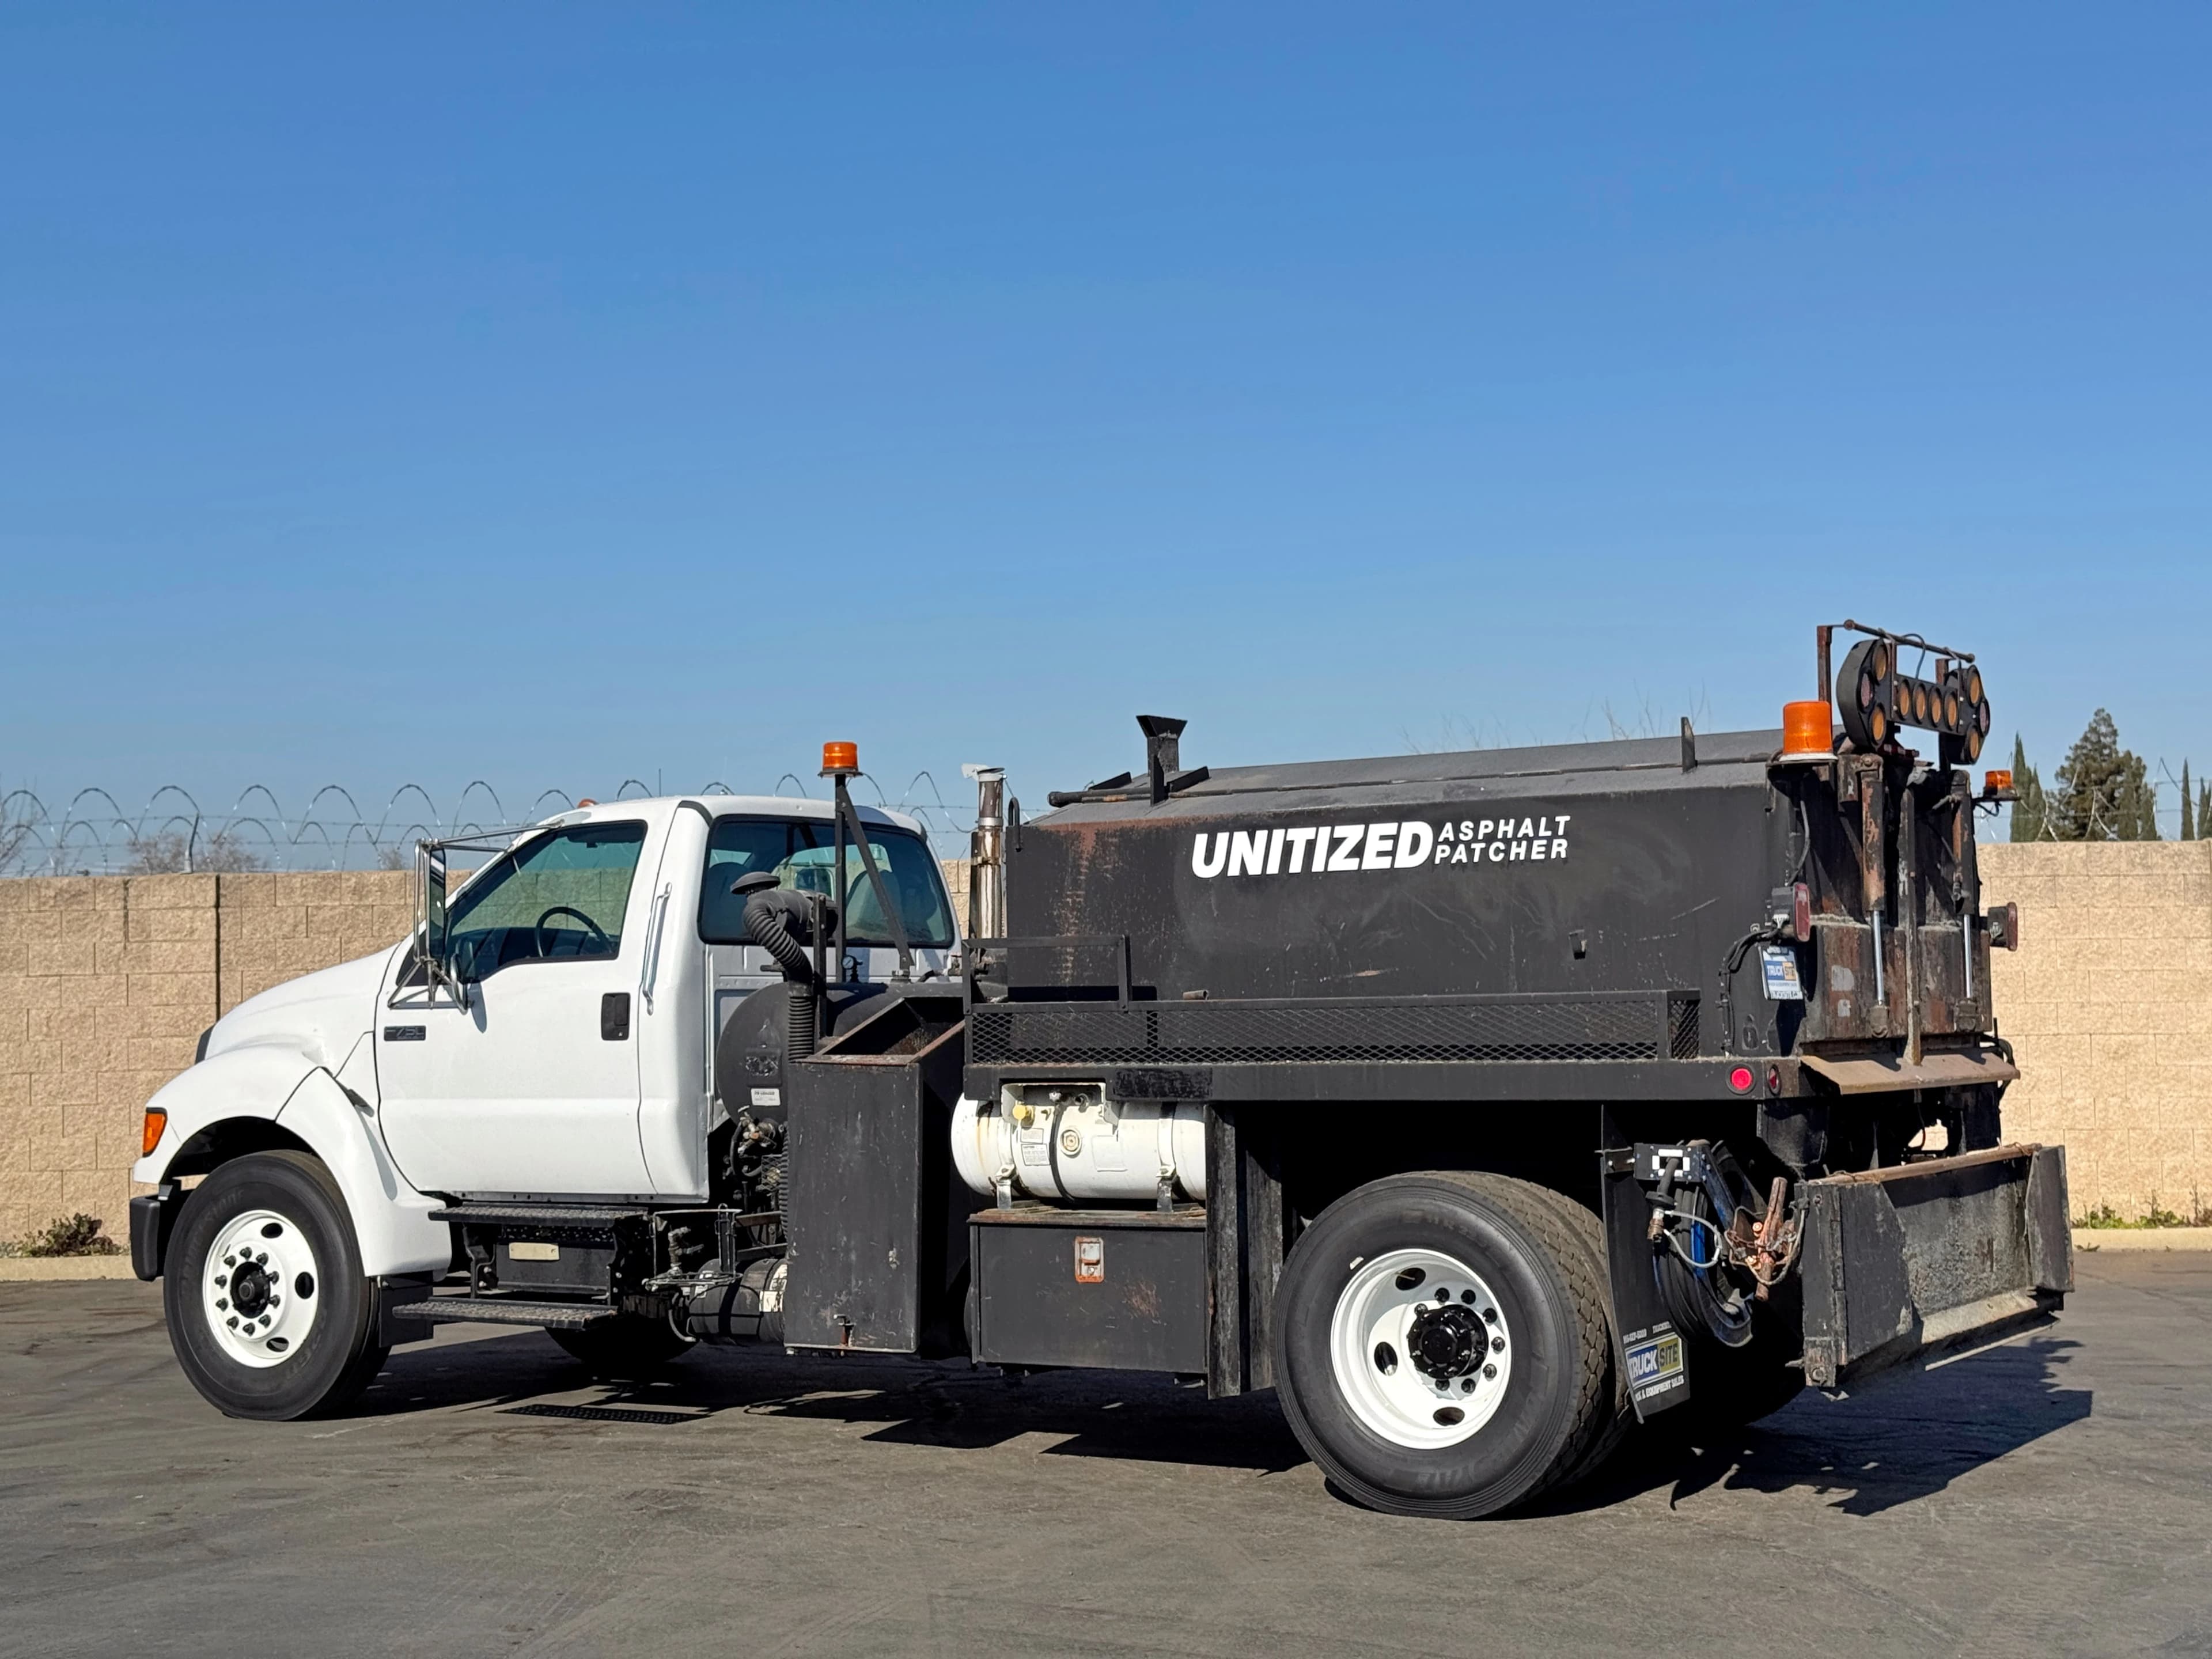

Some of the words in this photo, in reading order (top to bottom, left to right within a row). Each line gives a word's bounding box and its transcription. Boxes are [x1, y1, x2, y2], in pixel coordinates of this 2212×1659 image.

[1437, 815, 1571, 843] ASPHALT
[1191, 821, 1434, 879] UNITIZED
[1434, 839, 1568, 865] PATCHER
[1628, 1349, 1658, 1380] TRUCK
[1659, 1343, 1679, 1367] SITE
